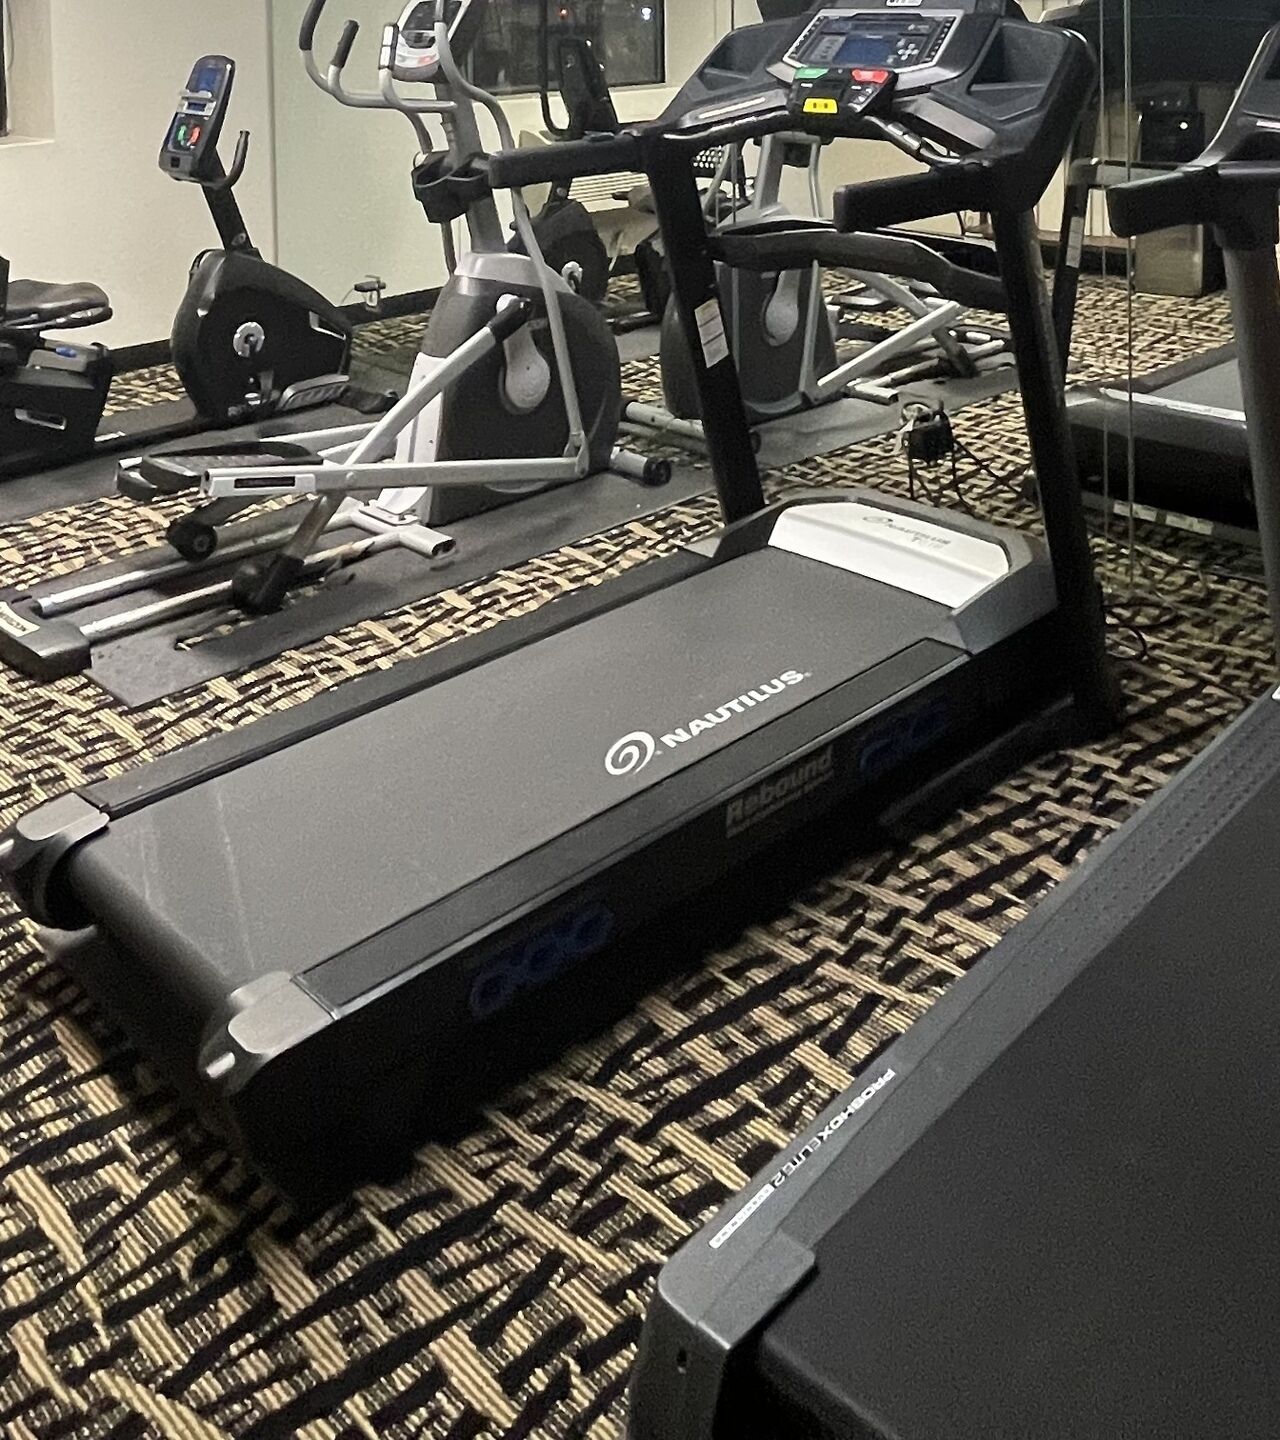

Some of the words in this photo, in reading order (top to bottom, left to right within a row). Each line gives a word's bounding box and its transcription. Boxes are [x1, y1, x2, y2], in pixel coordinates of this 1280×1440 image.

[660, 670, 804, 748] NAUTILUS
[726, 744, 834, 828] Rebound
[817, 1068, 896, 1140] PROSHOX
[782, 1137, 822, 1176] ELITE
